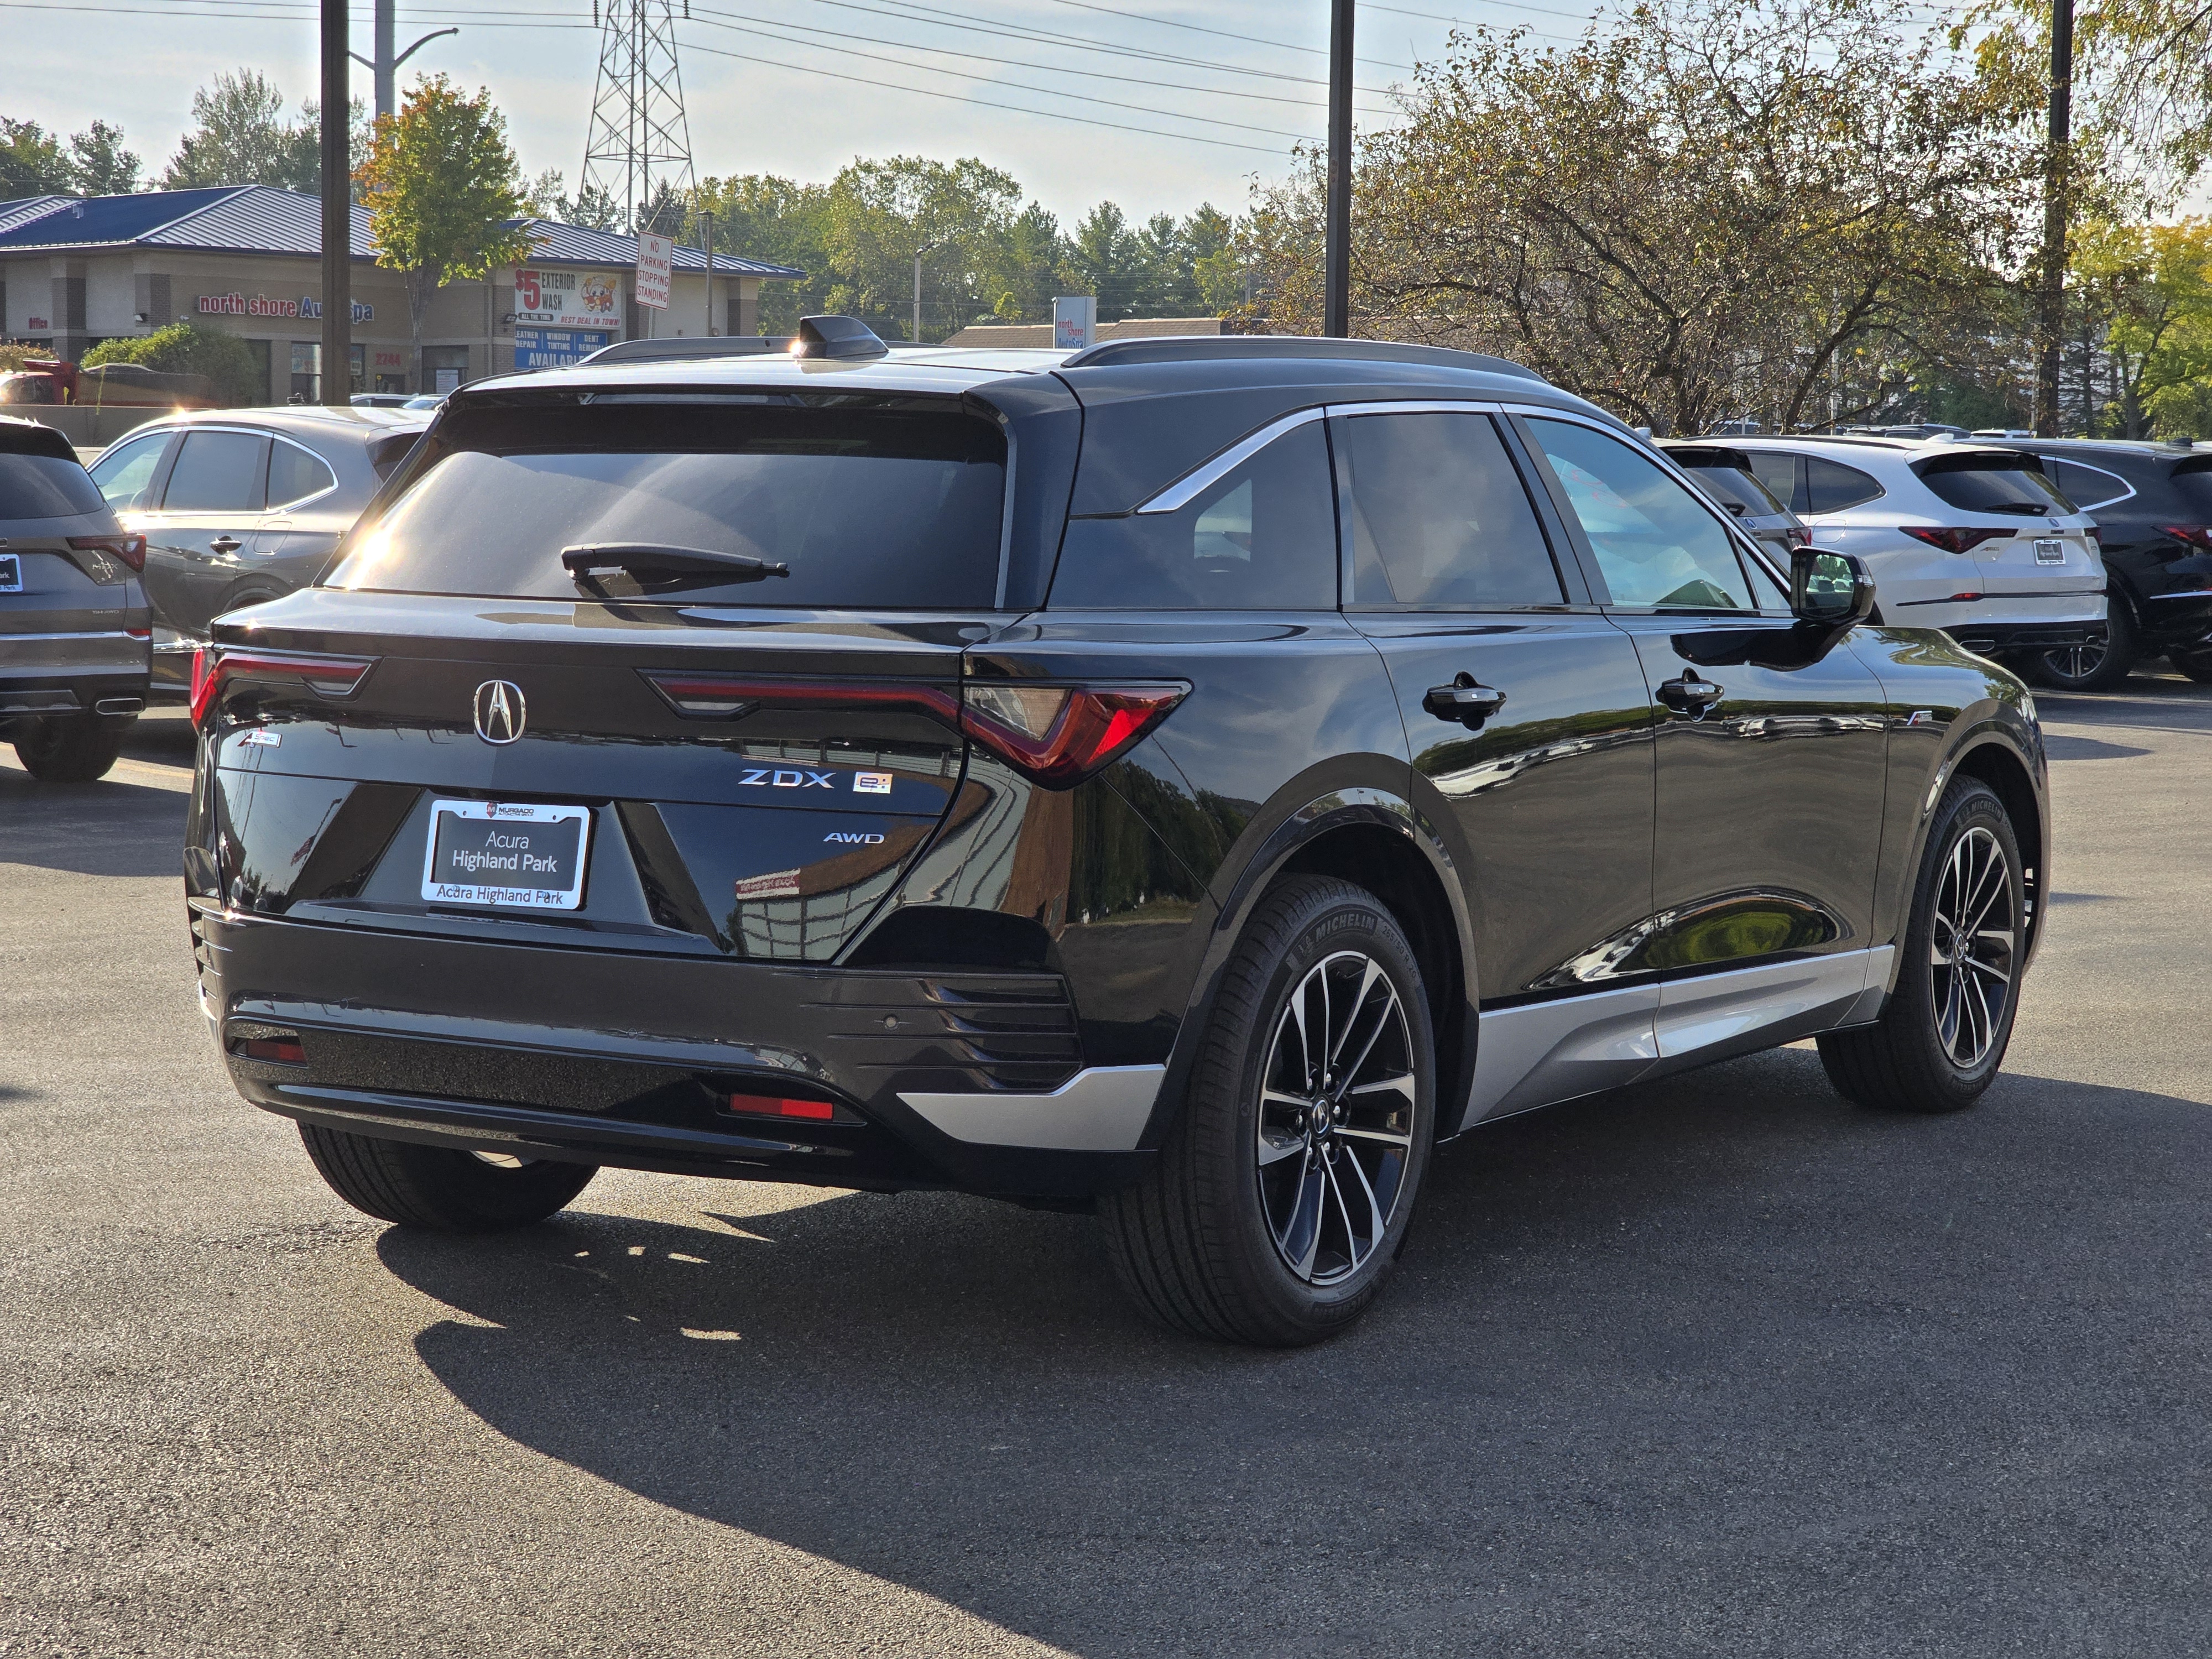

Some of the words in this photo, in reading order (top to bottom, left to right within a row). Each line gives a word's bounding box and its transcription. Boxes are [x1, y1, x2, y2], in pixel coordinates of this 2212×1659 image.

[650, 241, 659, 253] NO
[641, 254, 668, 271] PARKING
[541, 272, 576, 290] EXTERIOR
[638, 270, 669, 287] STOPPING
[515, 269, 541, 310] $5
[638, 285, 667, 302] STANDING
[200, 292, 245, 314] north
[249, 294, 296, 317] shore
[300, 296, 374, 325] Aupa
[542, 294, 562, 311] WASH
[602, 318, 620, 326] TOWN!
[1058, 319, 1073, 328] north
[546, 333, 571, 341] WINDOW
[584, 335, 599, 343] DENT
[1068, 327, 1084, 336] shore
[515, 340, 536, 348] REPAIR
[547, 342, 570, 351] TINTING
[375, 352, 402, 366] 2744
[738, 769, 837, 789] ZDX
[1971, 800, 2001, 818] MICHELIN
[485, 830, 529, 849] Acura
[823, 832, 885, 844] AWD
[452, 850, 519, 872] Highland
[522, 854, 558, 873] Park
[436, 884, 472, 899] Acura
[477, 887, 531, 904] Highland
[535, 890, 564, 905] Park
[1316, 914, 1375, 942] MICHELIN
[1404, 953, 1410, 963] R
[1408, 963, 1417, 978] 20
